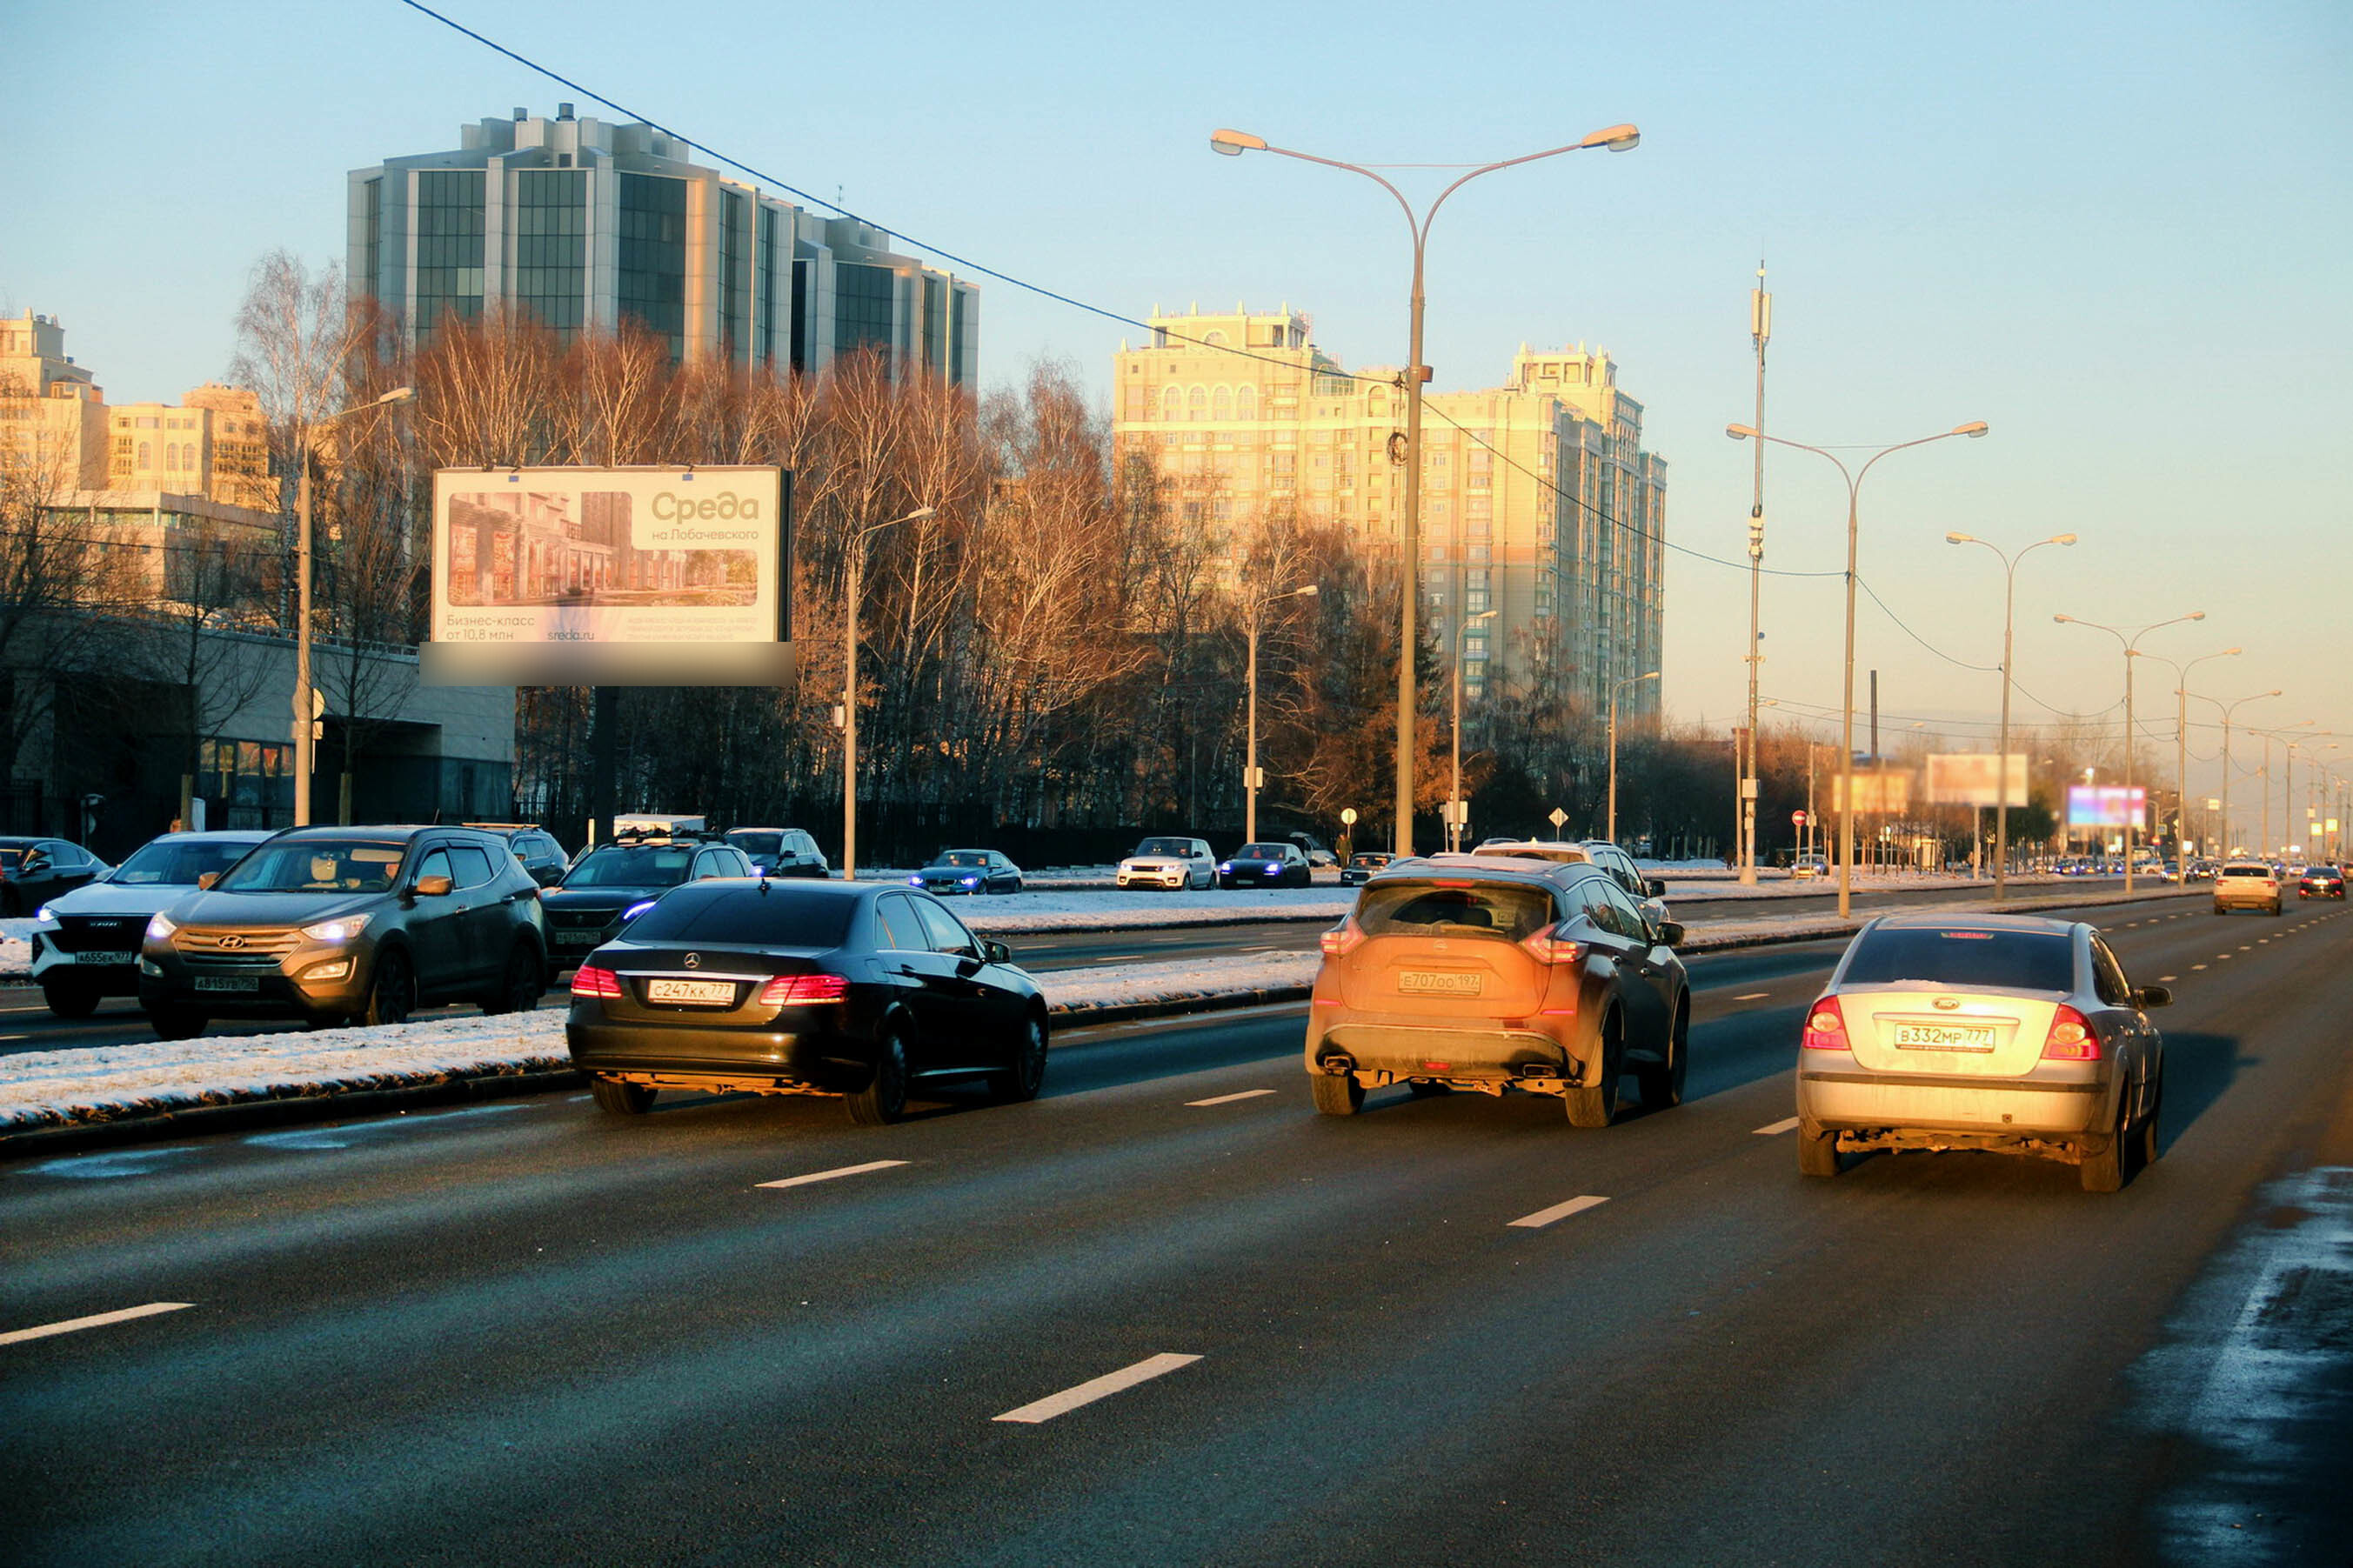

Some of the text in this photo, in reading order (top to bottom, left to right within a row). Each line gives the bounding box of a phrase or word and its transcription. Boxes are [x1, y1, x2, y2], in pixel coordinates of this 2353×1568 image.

[652, 490, 759, 525] Среда
[652, 528, 759, 541] на Лобачевского
[446, 614, 536, 627] Бизнес-класс
[446, 631, 460, 641] от
[464, 629, 486, 642] 10,8
[547, 629, 595, 642] sreda.ru
